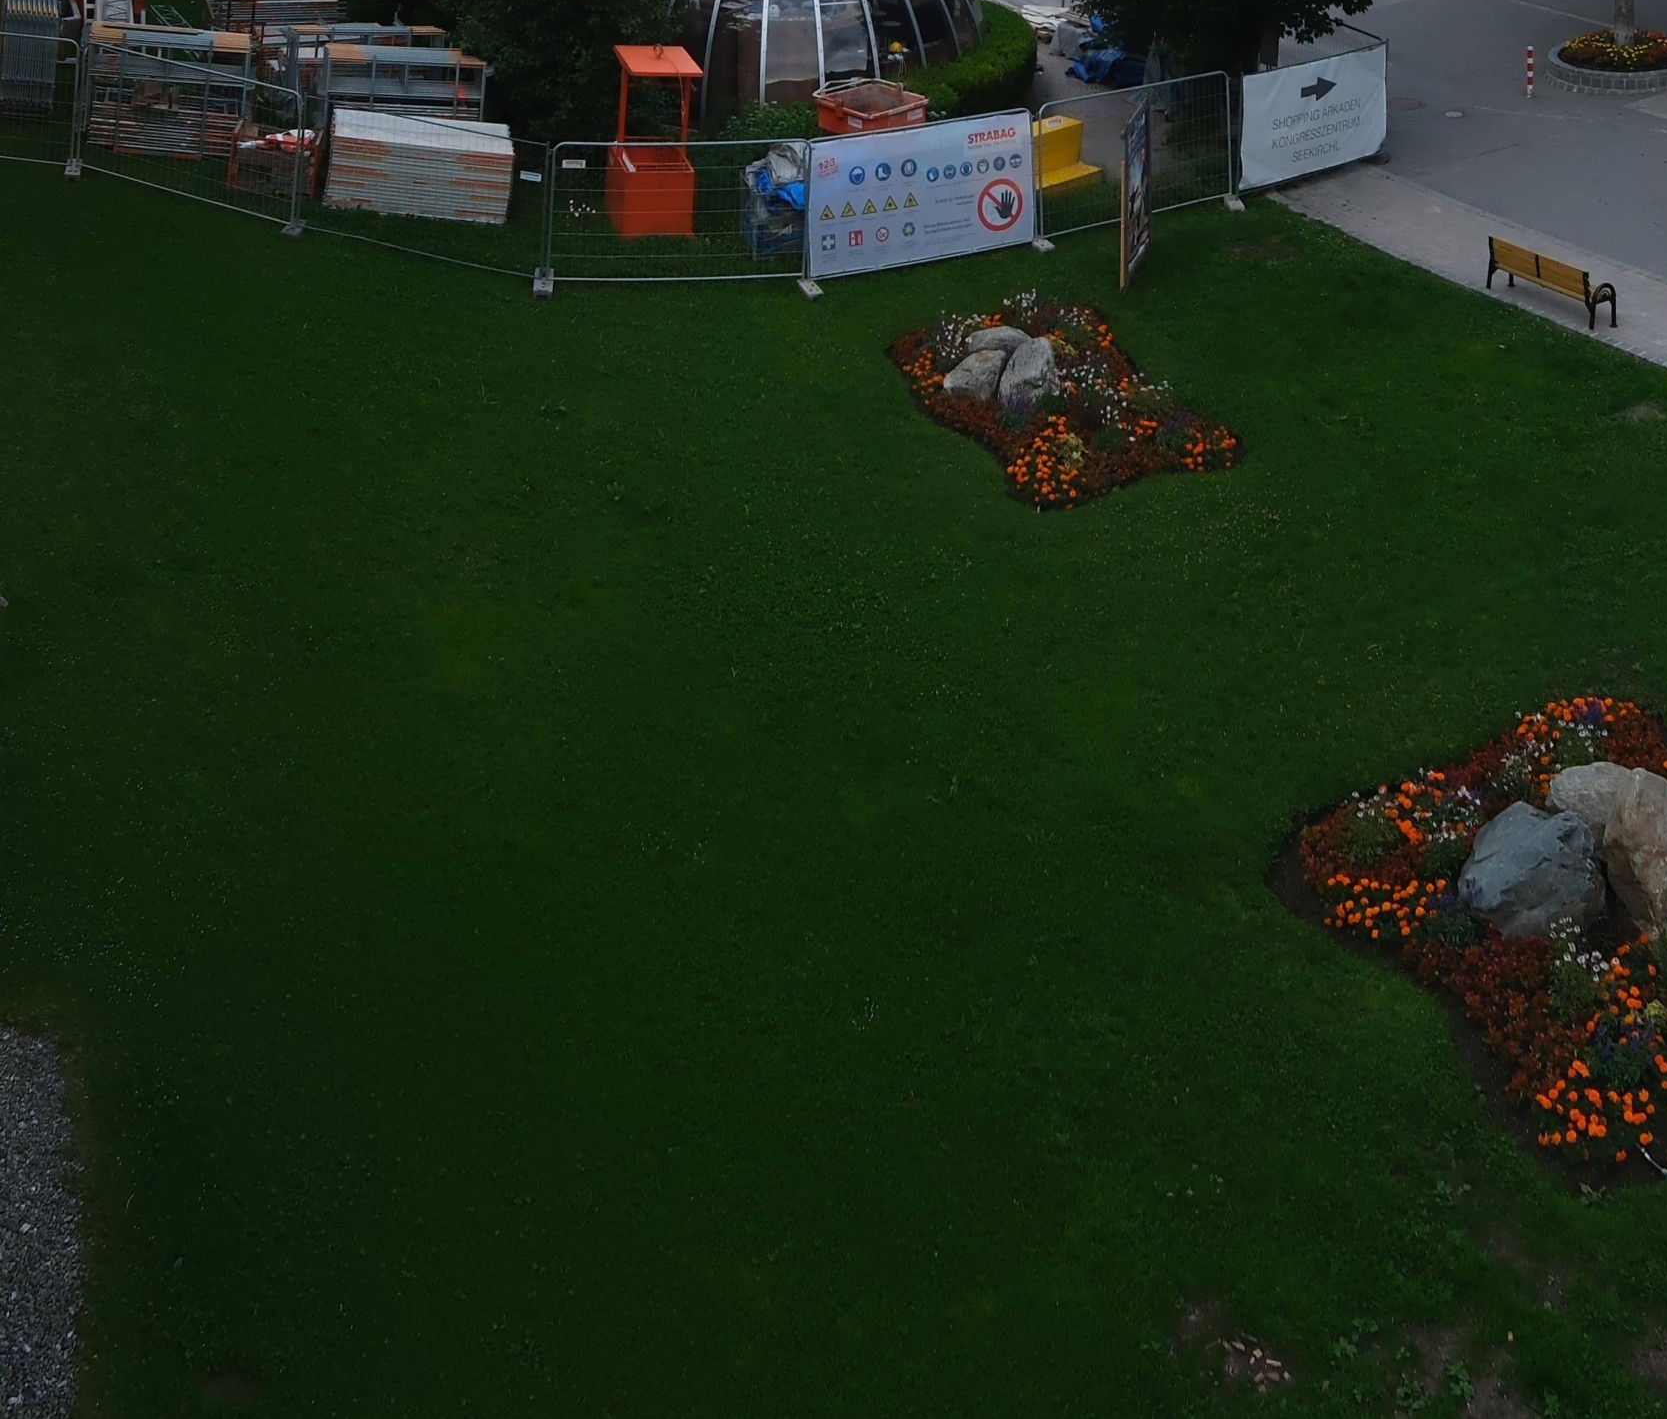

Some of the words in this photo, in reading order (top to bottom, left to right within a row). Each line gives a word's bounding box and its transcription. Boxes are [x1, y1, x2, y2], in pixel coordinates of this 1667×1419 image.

[1272, 109, 1320, 130] SHOPPING
[1322, 99, 1361, 119] ARKADEN
[967, 127, 1016, 144] STRABAG
[1271, 116, 1361, 149] KONGRESSZENTRUM
[1292, 141, 1340, 163] SEEKIRCHL
